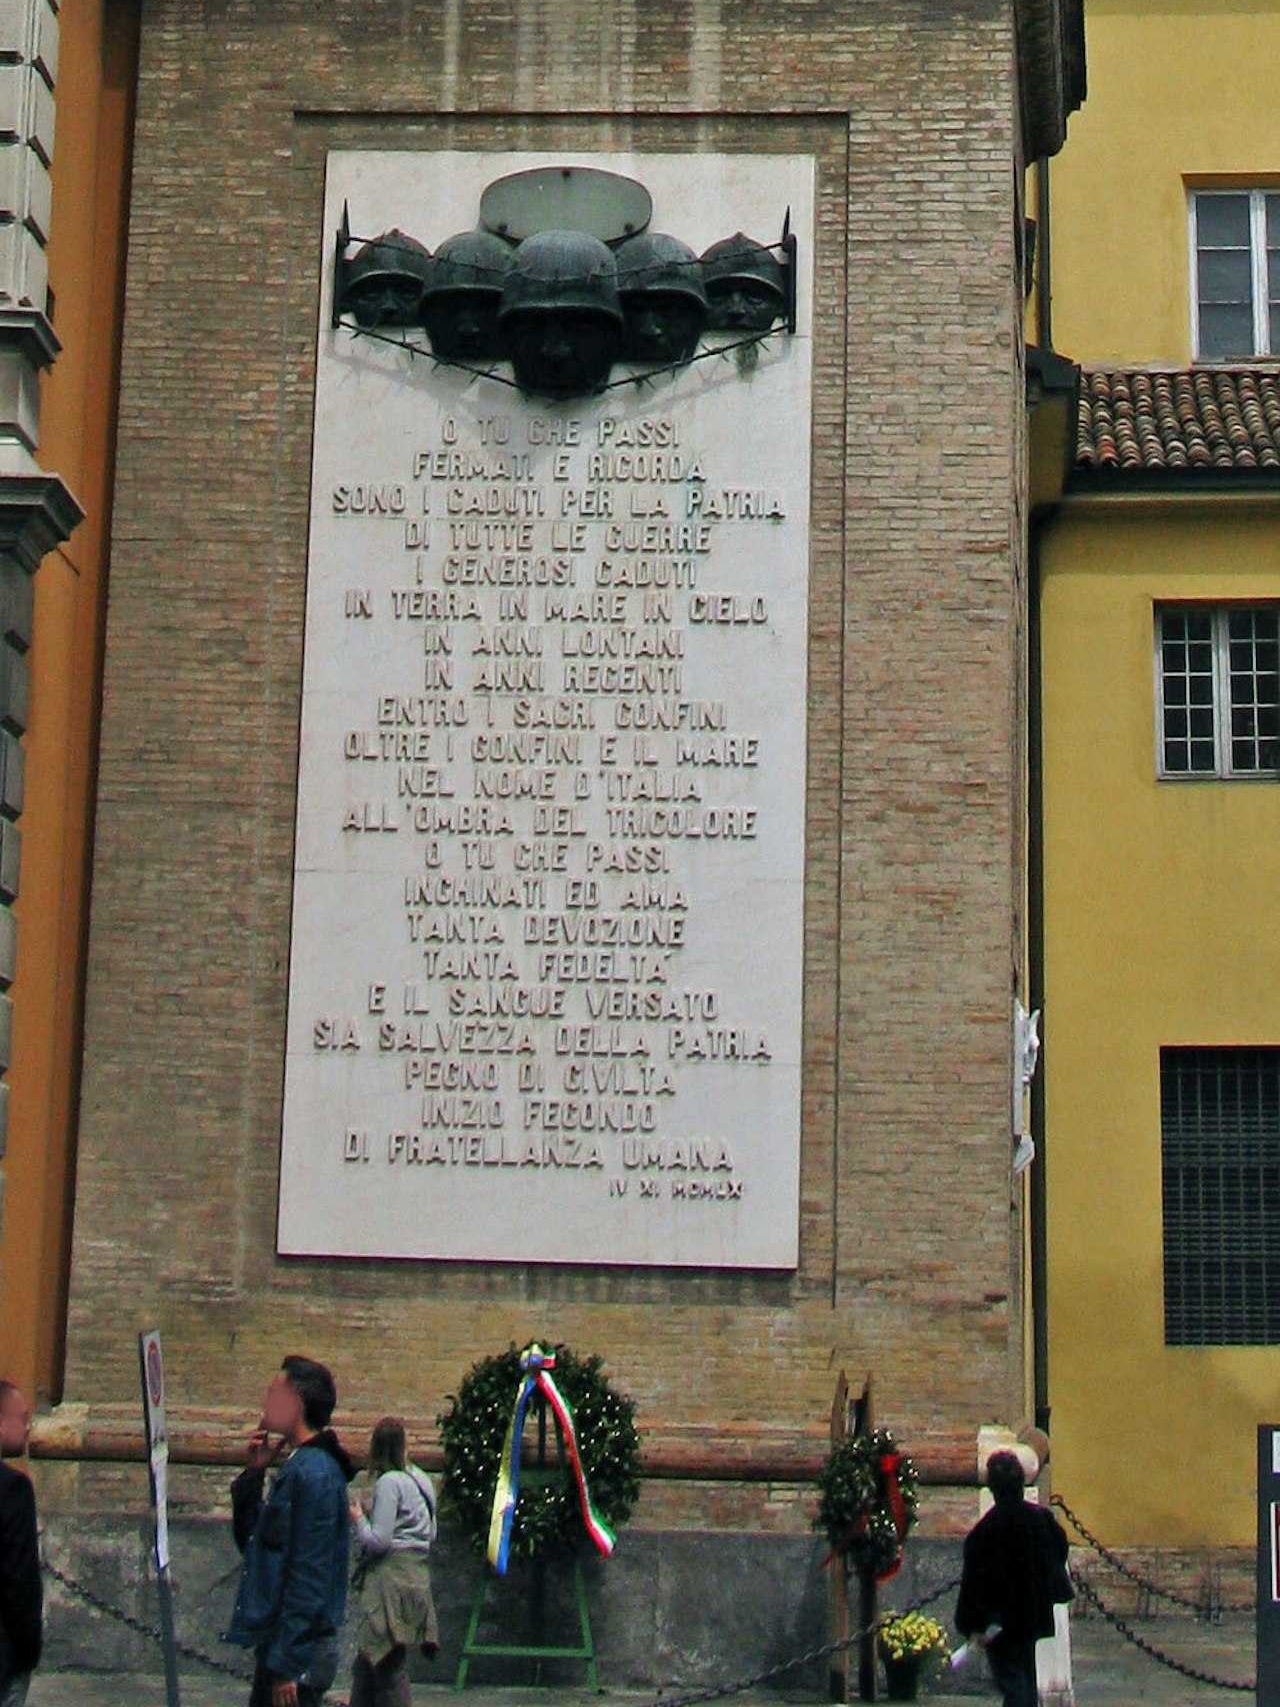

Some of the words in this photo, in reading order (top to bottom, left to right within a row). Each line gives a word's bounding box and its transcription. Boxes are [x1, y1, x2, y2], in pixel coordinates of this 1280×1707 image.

[442, 418, 456, 446] O
[478, 417, 510, 446] TU
[527, 418, 580, 447] CHE
[598, 419, 680, 449] PASSI
[413, 452, 534, 482] FERMATI
[553, 453, 569, 481] E
[588, 453, 706, 483] RICORDA
[333, 486, 406, 513] SONO
[422, 488, 429, 514] I
[447, 488, 544, 517] CADUTI
[561, 488, 613, 517] PER
[630, 489, 669, 517] LA
[686, 489, 785, 519] PATRIA
[405, 520, 429, 549] DI
[449, 521, 533, 551] TUTTE
[551, 522, 586, 551] LE
[605, 523, 712, 553] GUERRE
[417, 555, 423, 583] I
[443, 556, 577, 585] GENEROSI
[595, 557, 697, 588] CADUTI
[344, 590, 372, 618] IN
[391, 590, 481, 620] TERRA
[500, 592, 527, 621] IN
[544, 593, 626, 622] MARE
[644, 593, 672, 622] IN
[690, 595, 768, 624] CIELO
[424, 626, 452, 655] IN
[471, 626, 543, 657] ANNI
[561, 628, 685, 659] LONTANI
[424, 661, 453, 690] IN
[473, 661, 544, 693] ANNI
[564, 663, 683, 695] RECENTI
[377, 695, 469, 726] ENTRO
[487, 697, 494, 726] I
[513, 697, 594, 729] SACRI
[615, 697, 727, 731] CONFINI
[344, 730, 430, 762] OLTRE
[446, 733, 453, 762] I
[471, 734, 583, 764] CONFINI
[600, 736, 616, 764] E
[634, 736, 658, 766] IL
[676, 736, 758, 767] MARE
[398, 767, 455, 797] NEL
[474, 769, 556, 799] NOME
[575, 770, 701, 802] D'ITALIA
[342, 802, 514, 835] ALL'OMBRA
[533, 806, 587, 836] DEL
[605, 806, 758, 839] TRICOLORE
[425, 840, 440, 869] O
[462, 840, 494, 870] TU
[514, 841, 568, 871] CHE
[587, 843, 669, 874] PASSI
[405, 876, 546, 909] INCHINATI
[565, 878, 601, 910] ED
[621, 880, 688, 912] AMA
[407, 912, 505, 944] TANTA
[524, 915, 686, 947] DEVOZIONE
[422, 950, 519, 981] TANTA
[367, 985, 385, 1014] E
[403, 985, 429, 1015] IL
[448, 987, 566, 1018] SANGUE
[586, 987, 719, 1021] VERSATO
[313, 1019, 360, 1051] SIA
[378, 1019, 536, 1054] SALVEZZA
[555, 1025, 650, 1056] DELLA
[668, 1026, 772, 1061] PATRIA
[405, 1059, 500, 1091] PEGNO
[519, 1061, 544, 1092] DI
[421, 1097, 505, 1129] INIZIO
[524, 1099, 658, 1133] FECONDO
[344, 1130, 370, 1162] DI
[388, 1132, 604, 1169] FRATELLANZA
[622, 1137, 734, 1171] UMANA
[609, 1180, 627, 1198] IV
[640, 1181, 659, 1198] XI
[671, 1181, 744, 1201] MCMLX
